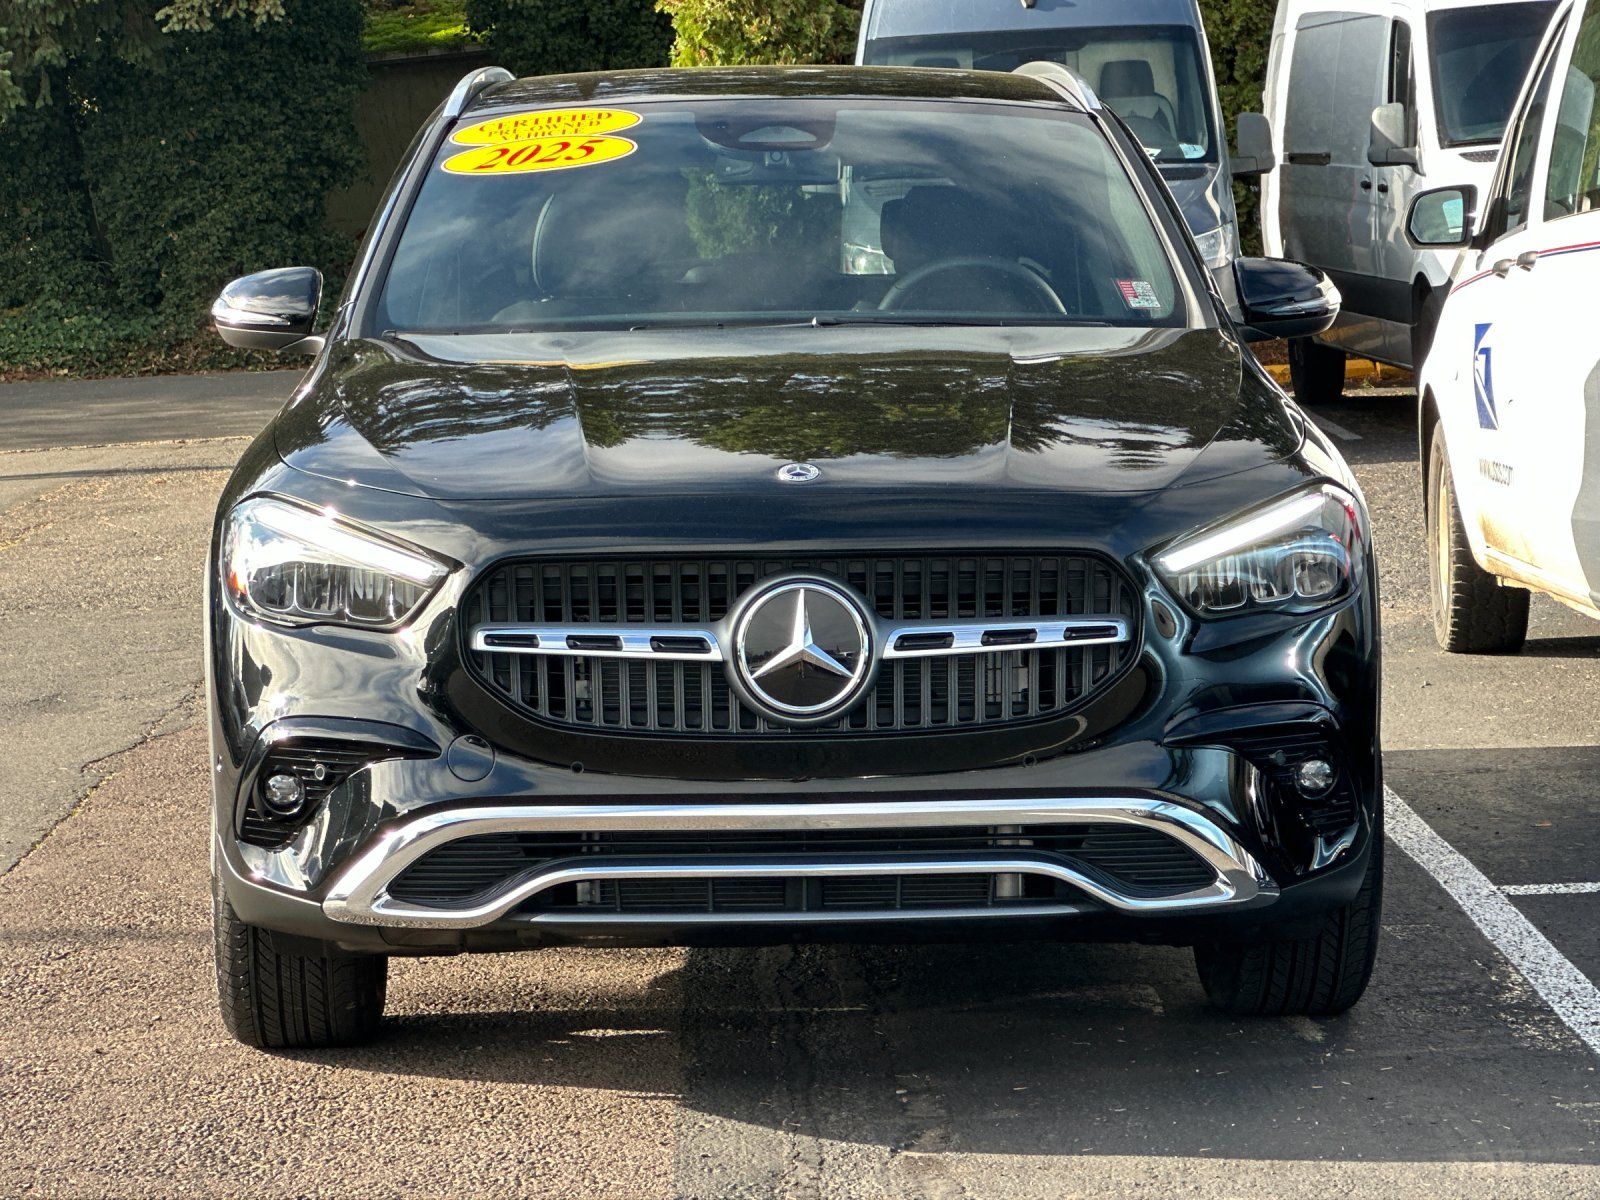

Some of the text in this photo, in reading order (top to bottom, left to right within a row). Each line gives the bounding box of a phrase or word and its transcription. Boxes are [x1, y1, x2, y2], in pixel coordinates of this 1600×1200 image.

[479, 112, 613, 132] CERTIFIED
[488, 120, 601, 137] PRE-OWNED
[502, 129, 584, 141] VEHICLE
[474, 139, 605, 170] 2025
